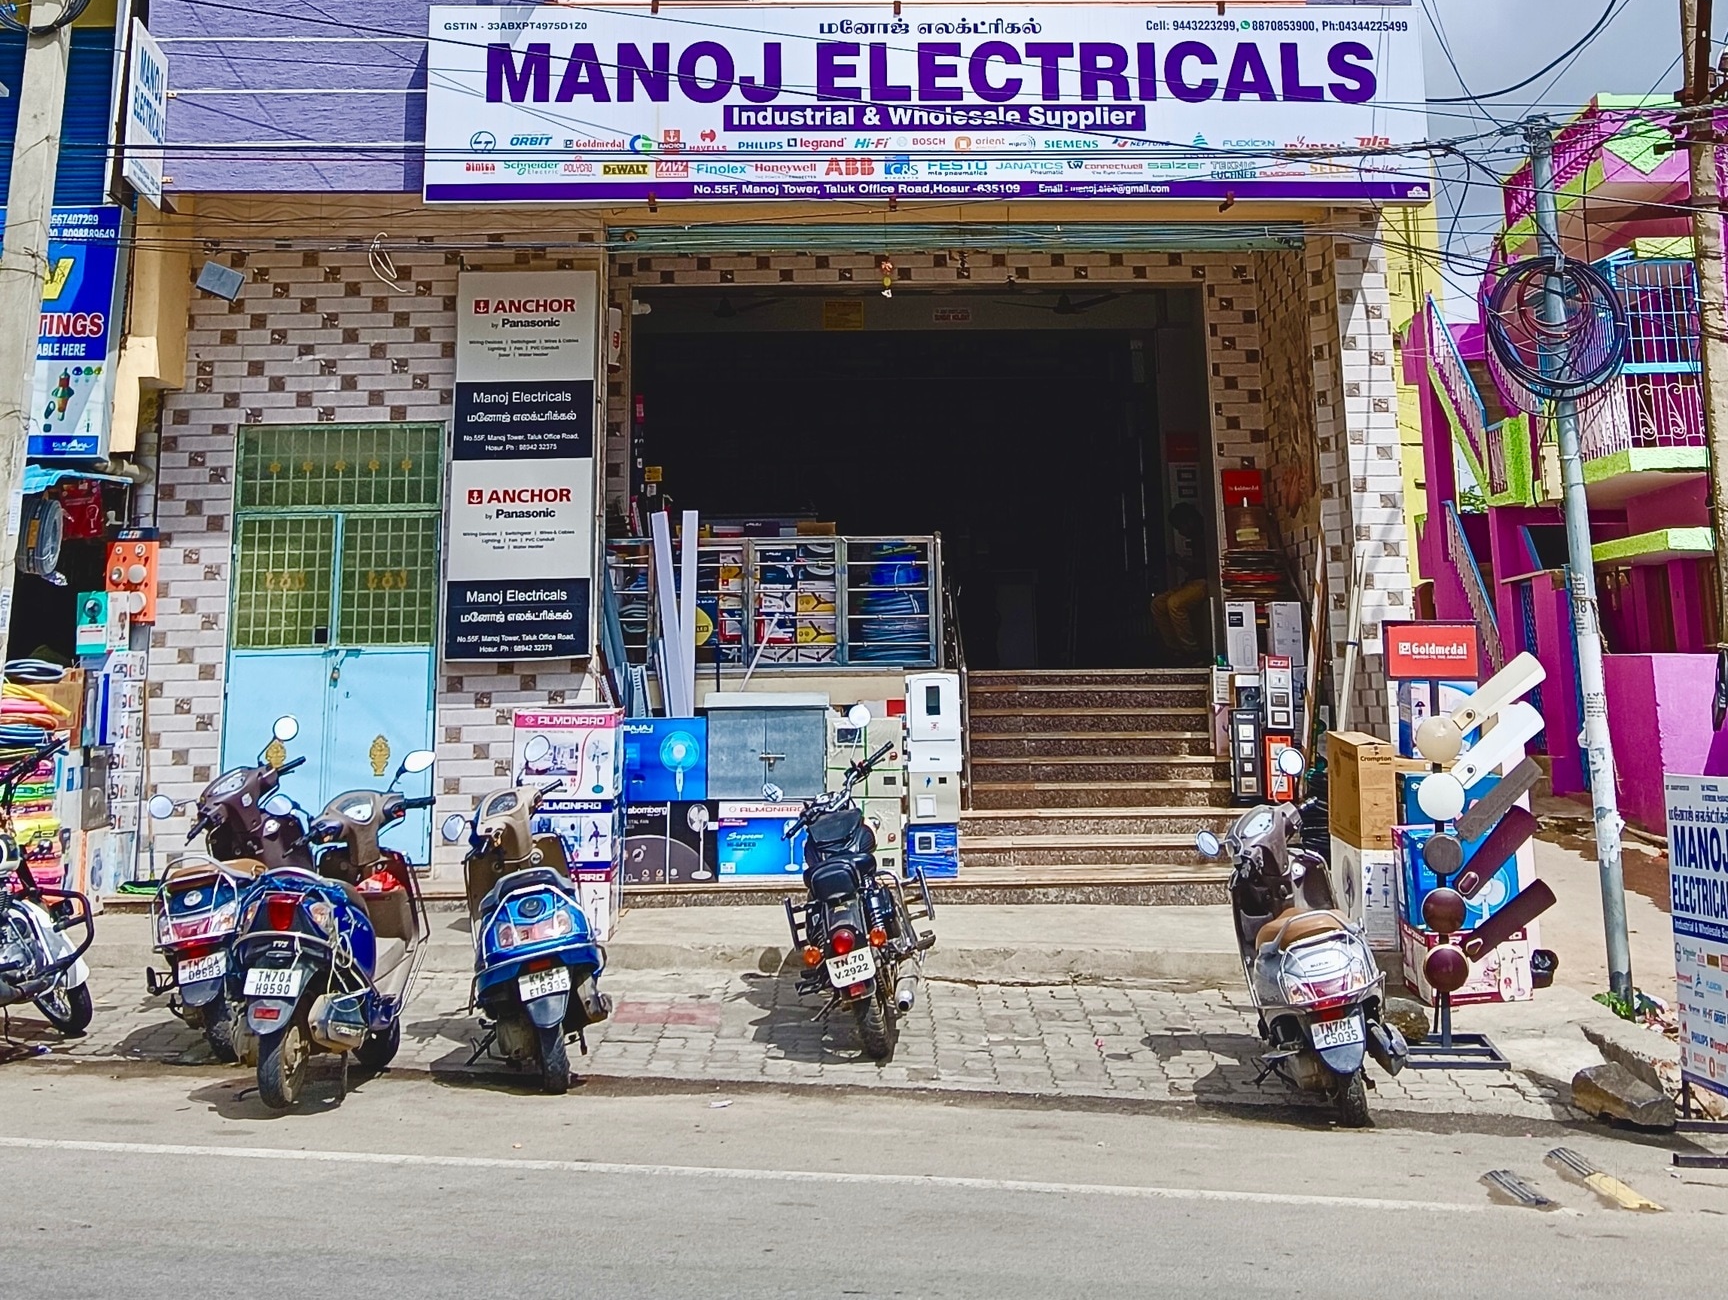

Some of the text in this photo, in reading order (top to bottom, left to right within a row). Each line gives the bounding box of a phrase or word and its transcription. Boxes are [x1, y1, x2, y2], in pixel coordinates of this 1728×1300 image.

[444, 22, 478, 31] GSTIN
[819, 17, 1042, 35] மனோஜ் எலக்ட்ரிகல்
[1146, 20, 1408, 33] Cell: 9443223299, 8870853900, Ph:04344225499
[485, 41, 1377, 104] MANOJ ELECTRICALS
[732, 106, 1136, 130] Industrial & Wholesale Supplier
[510, 136, 553, 146] ORBIT
[576, 139, 625, 149] Goldmedal
[738, 141, 783, 150] PHILIPS
[800, 137, 844, 150] legrand
[854, 137, 889, 149] Hi-Fi
[912, 137, 946, 146] BOSCH
[975, 136, 1006, 145] orient
[1044, 140, 1099, 149] SIEMENS
[503, 161, 560, 174] Schneider
[696, 164, 746, 174] Finolex
[754, 163, 817, 174] Honeywell
[825, 157, 875, 176] ABB
[995, 161, 1063, 170] JANATICS
[1147, 160, 1206, 170] salzer
[1210, 161, 1257, 169] TEKNIC
[693, 184, 739, 195] No.55F,
[741, 184, 780, 196] Manoj
[783, 184, 820, 195] Tower,
[823, 184, 855, 194] Taluk
[858, 184, 895, 194] Office
[1038, 184, 1063, 193] Email
[493, 299, 576, 314] ANCHOR
[501, 317, 561, 328] Panasonic
[61, 344, 86, 356] HERE
[473, 391, 572, 405] Manoj Electricals
[487, 433, 506, 443] Manoj
[487, 488, 572, 503] ANCHOR
[495, 507, 556, 519] Panasonic
[466, 589, 568, 605] Manoj Electricals
[481, 635, 500, 643] Manoj
[1411, 642, 1467, 655] Goldmedal
[537, 715, 606, 726] ALMONARD
[1360, 755, 1392, 763] Crompton
[537, 800, 602, 811] ALMONARD
[1672, 873, 1728, 920] ELECTRICA
[273, 940, 289, 948] TVS
[834, 952, 865, 969] TN.70
[834, 962, 870, 980] V.2922
[255, 983, 290, 995] H9590
[1318, 1019, 1354, 1035] TN70A
[1323, 1030, 1359, 1046] C5035
